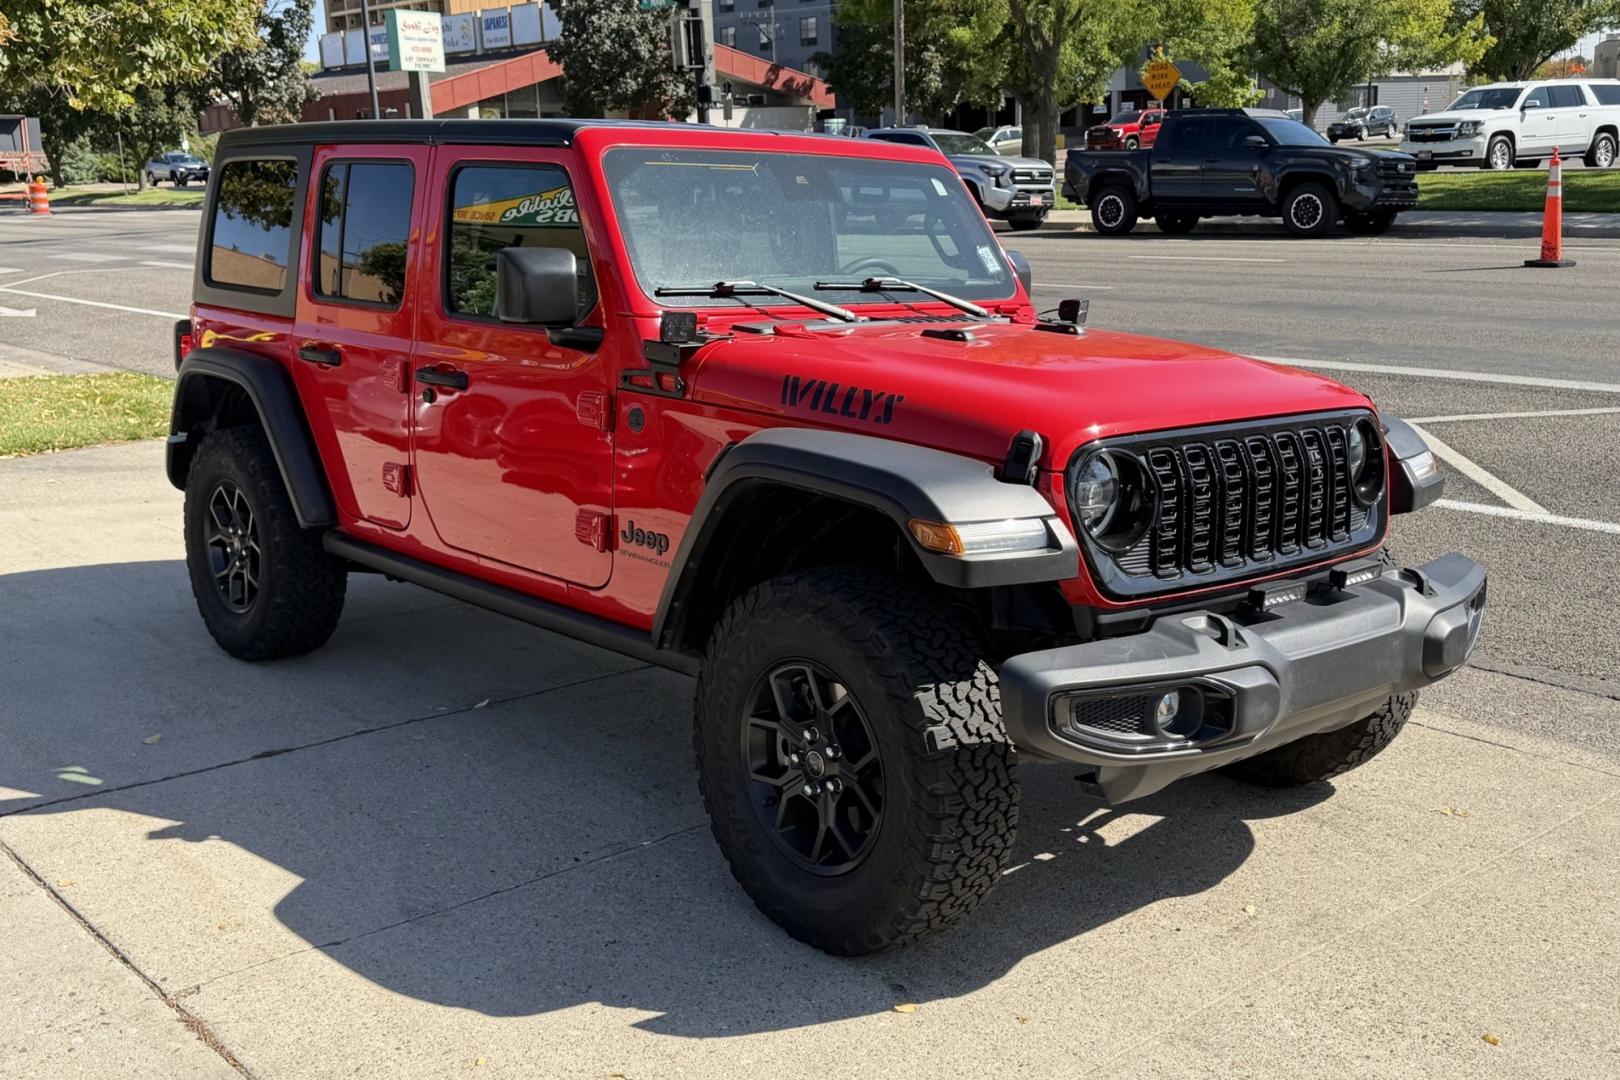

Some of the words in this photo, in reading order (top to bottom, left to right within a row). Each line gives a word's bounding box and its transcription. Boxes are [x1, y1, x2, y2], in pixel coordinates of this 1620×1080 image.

[484, 15, 508, 31] JAPANESE
[1151, 63, 1168, 71] ROAD
[1151, 81, 1171, 89] AHEAD
[781, 374, 904, 425] WILLYS
[621, 519, 669, 556] Jeep
